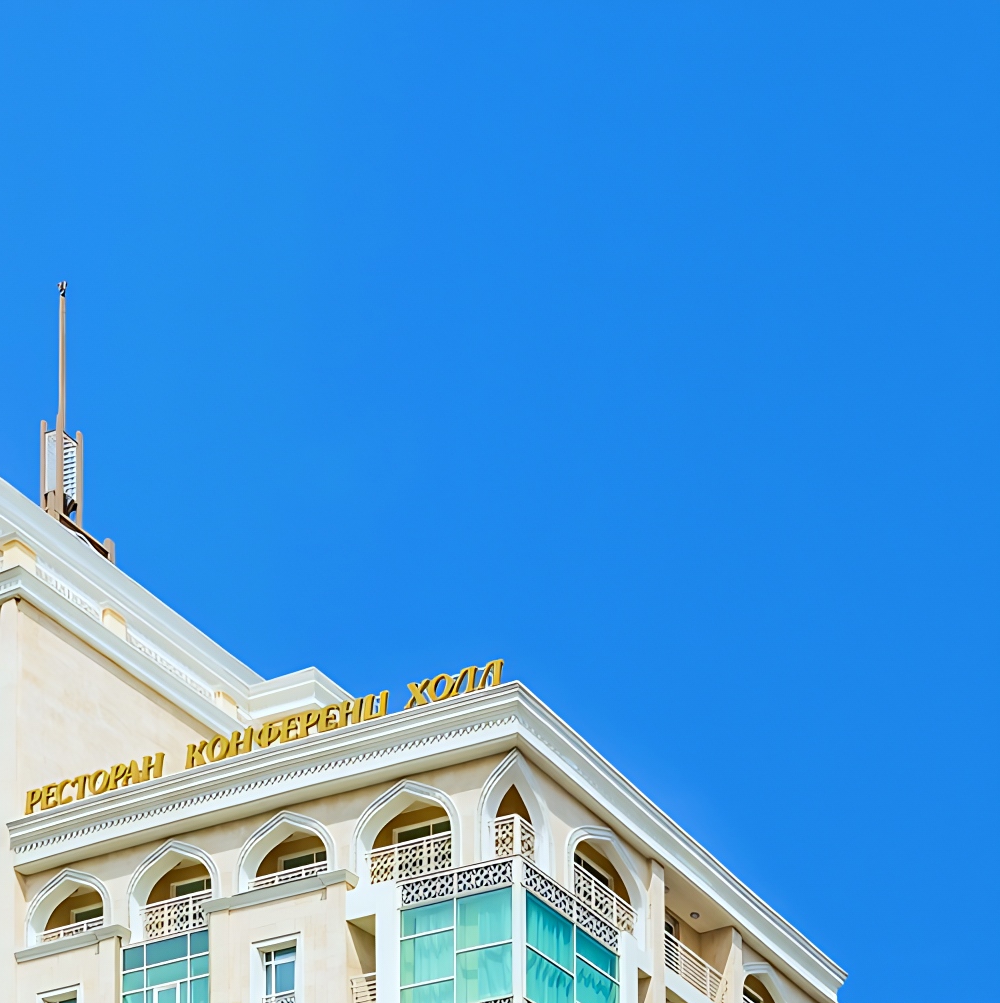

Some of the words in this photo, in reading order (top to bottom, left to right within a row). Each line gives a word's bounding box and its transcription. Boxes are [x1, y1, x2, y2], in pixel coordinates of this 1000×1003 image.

[24, 752, 165, 816] РЕСТОРАН
[185, 690, 389, 770] КОНФЕРЕНЦ
[403, 658, 504, 710] ХОЛЛ
